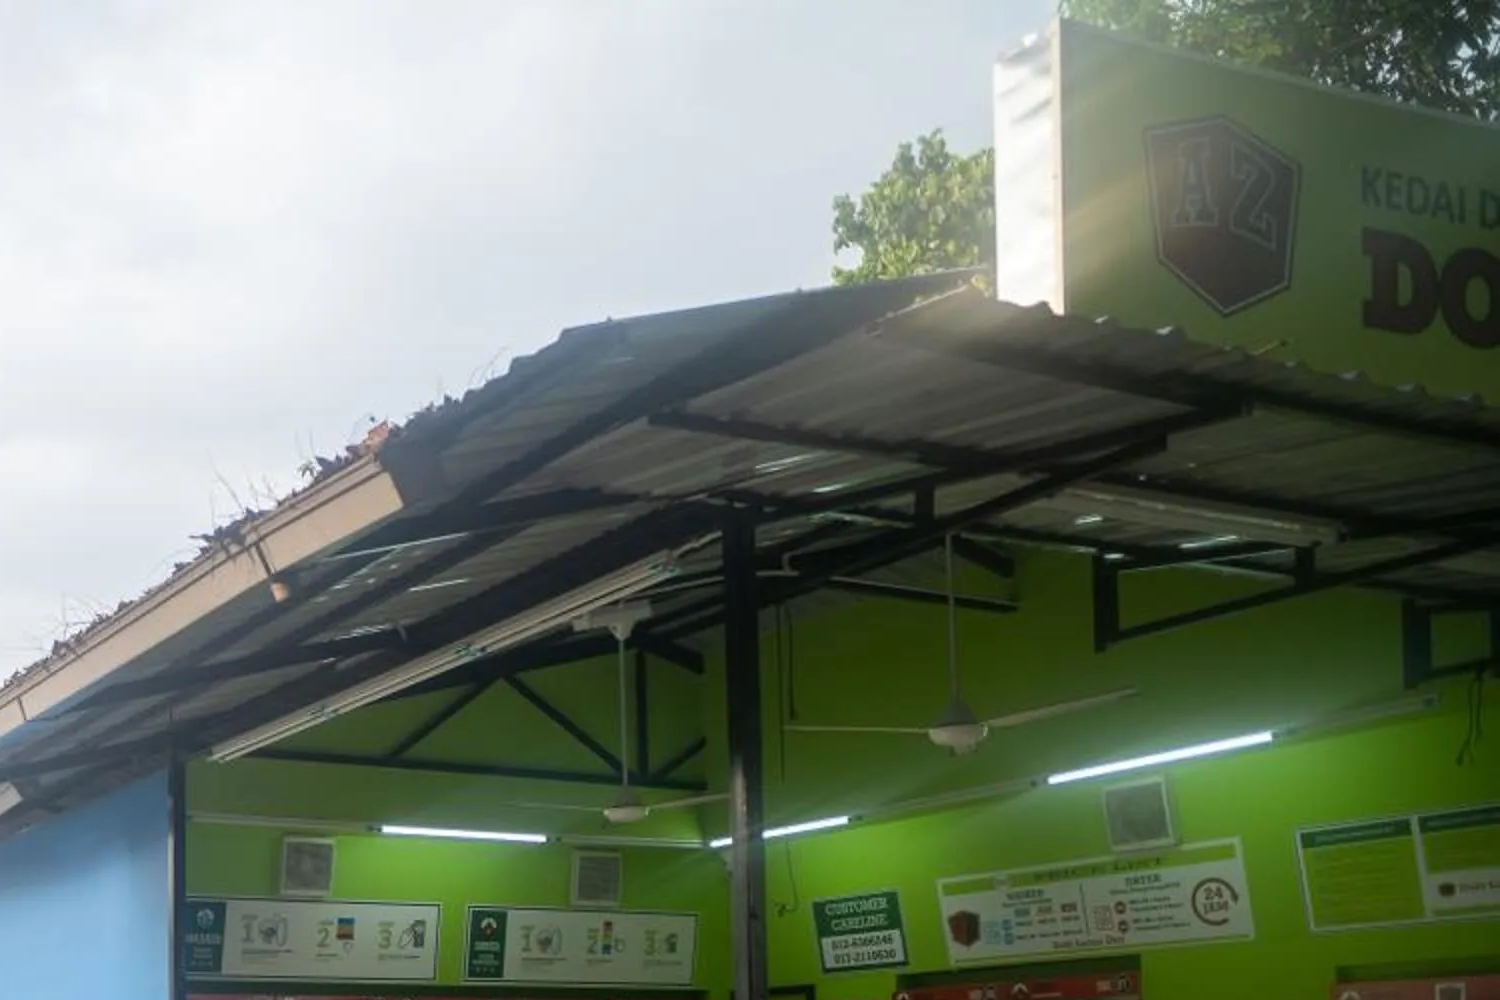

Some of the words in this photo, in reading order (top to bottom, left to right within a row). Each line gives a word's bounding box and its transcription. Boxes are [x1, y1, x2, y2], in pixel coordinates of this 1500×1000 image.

[1360, 164, 1467, 226] KEDAI
[1360, 226, 1500, 350] DO
[1203, 886, 1223, 901] 24
[825, 897, 889, 916] CUSTOMER
[830, 913, 889, 931] CARELINE
[316, 927, 330, 948] 2
[378, 928, 392, 949] 3
